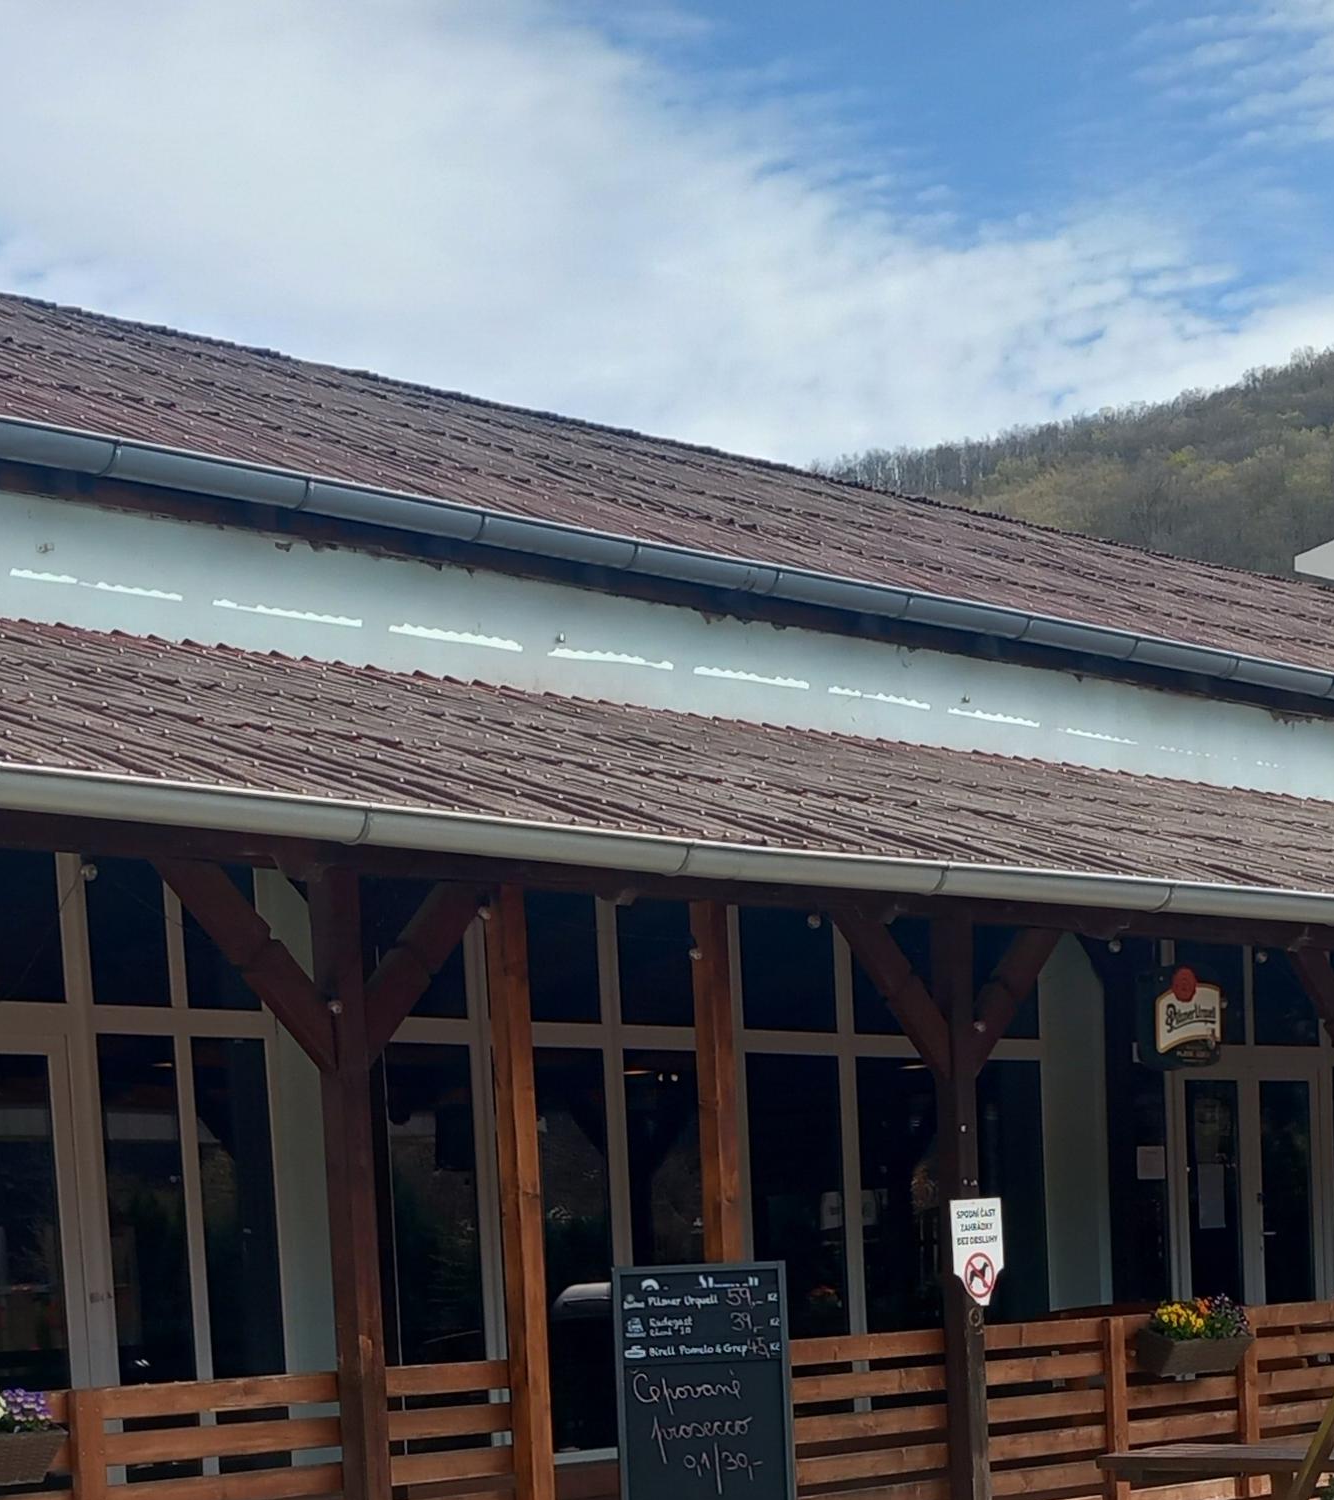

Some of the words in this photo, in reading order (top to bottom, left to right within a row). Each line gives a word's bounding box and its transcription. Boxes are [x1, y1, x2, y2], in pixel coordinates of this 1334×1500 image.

[647, 1296, 682, 1306] Pilsner
[684, 1294, 718, 1310] Urquell
[649, 1345, 675, 1357] Birell
[679, 1344, 714, 1355] Pomelo
[632, 1368, 742, 1415] Čepované
[651, 1415, 752, 1464] prosecco
